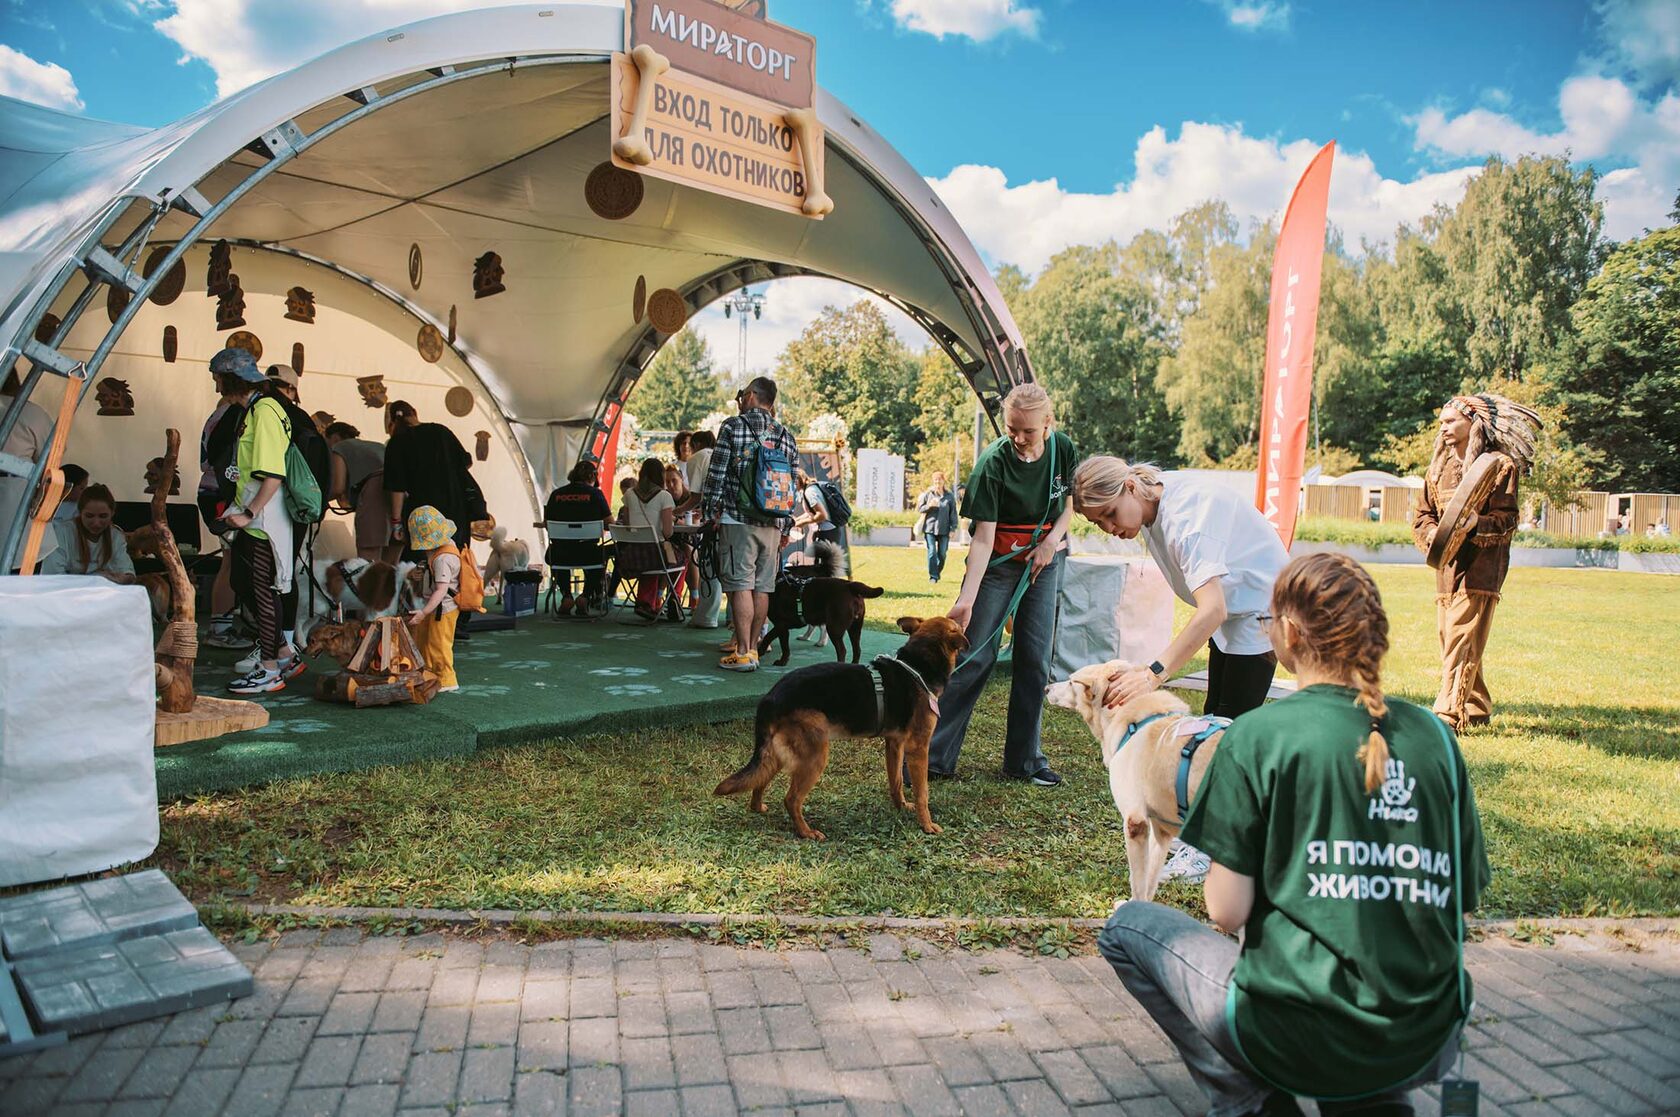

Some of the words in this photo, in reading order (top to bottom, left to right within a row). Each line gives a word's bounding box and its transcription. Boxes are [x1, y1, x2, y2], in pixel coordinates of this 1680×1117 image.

[651, 4, 796, 81] МИРАТОРГ
[654, 83, 712, 132] ВХОД
[720, 106, 793, 152] ТОЛЬКО
[691, 142, 805, 198] ОХОТНИКОВ
[1306, 840, 1328, 865] Я
